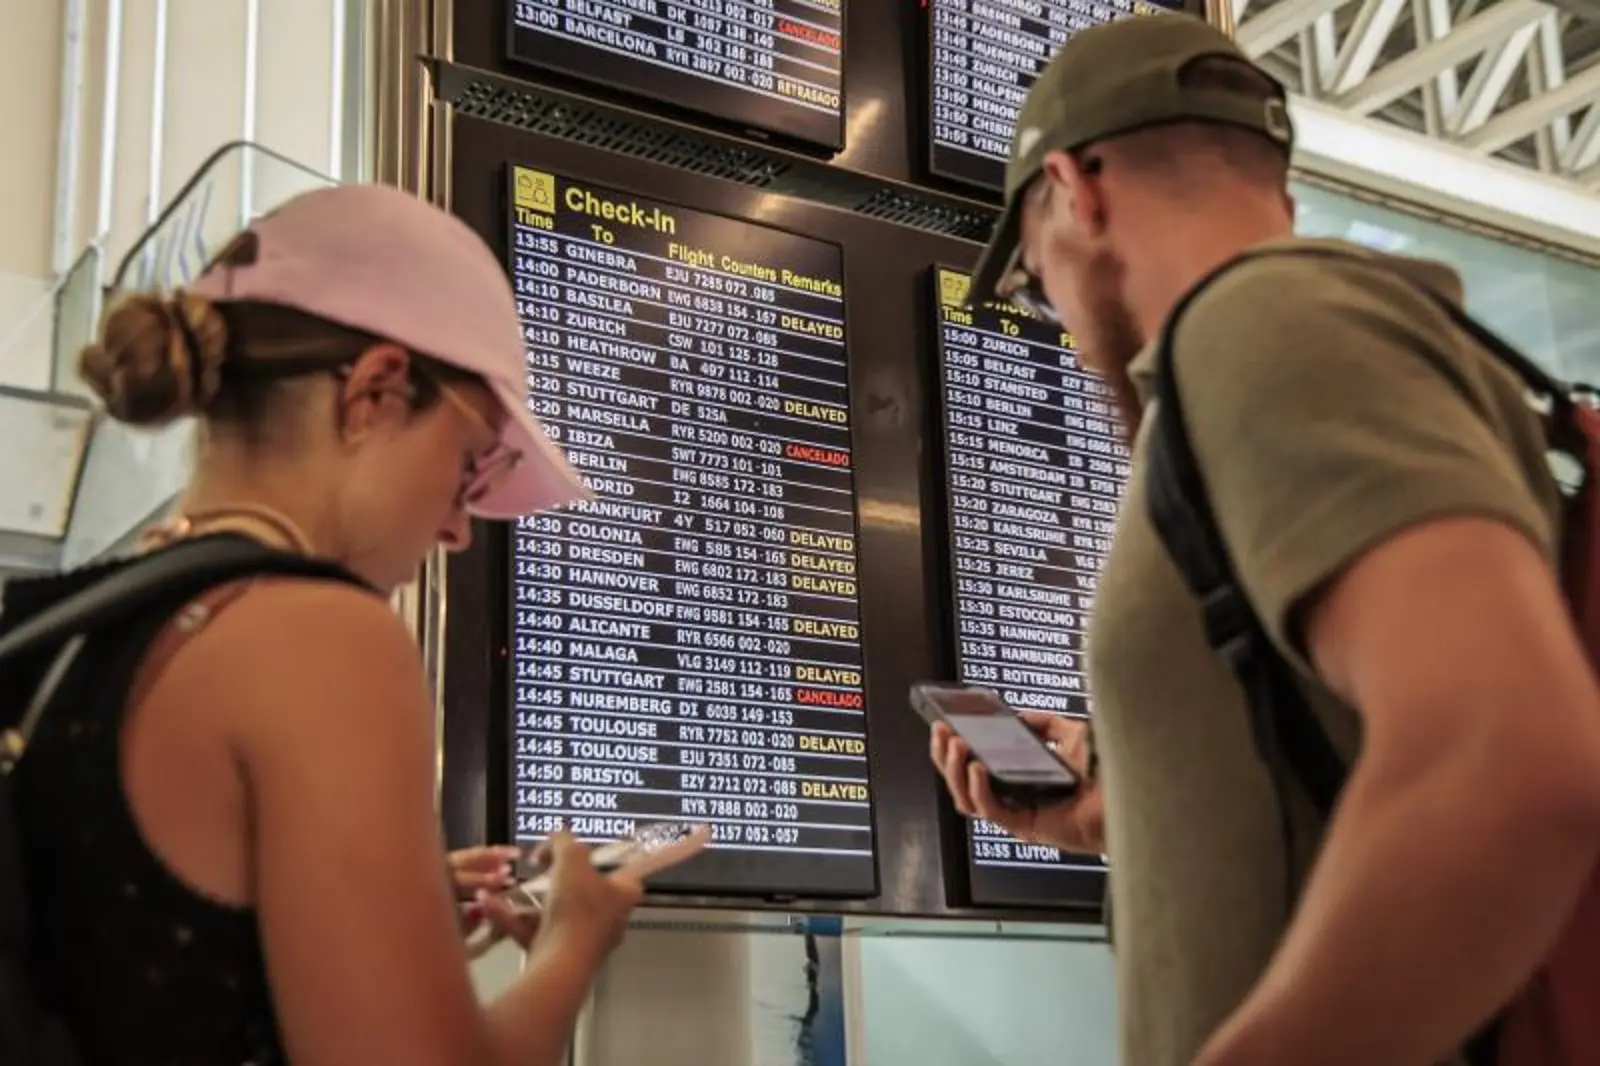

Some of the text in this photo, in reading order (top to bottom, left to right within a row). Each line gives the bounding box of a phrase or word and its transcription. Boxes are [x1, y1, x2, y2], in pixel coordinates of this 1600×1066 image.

[566, 0, 632, 27] BELFAST
[667, 6, 686, 23] DK
[972, 20, 1045, 55] PADERBORN
[516, 4, 839, 109] 13:00 BARCELONA RETRASADO
[972, 60, 1018, 84] ZURICH
[972, 135, 1011, 156] VIENA
[515, 207, 842, 297] Time To Flight Counters Remarks
[516, 231, 689, 284] 13:55 GINEBRA EJU
[516, 255, 842, 339] 14:00 PADERBORN DELAYED
[516, 277, 724, 336] 14:10 BASILEA EJU 7277
[516, 300, 724, 357] 14:10 ZURICH 101
[943, 306, 973, 325] Time
[1000, 319, 1020, 336] To
[567, 334, 656, 364] HEATHROW
[669, 355, 689, 371] BA
[943, 327, 1029, 358] 15:00 ZURICH
[944, 348, 1037, 381] 15:05 BELFAST
[525, 349, 847, 424] 4:15 WEEZE DELAYED
[526, 373, 689, 416] 4:20 STUTTGART DE
[945, 368, 1048, 402] 15:10 STANSTED
[947, 388, 1032, 418] 15:10 BERLIN
[527, 397, 560, 416] 4:20
[567, 404, 649, 432] MARSELLA
[671, 423, 695, 439] RYR
[786, 444, 849, 466] CANCELADO
[948, 409, 1018, 436] 15:15 LINZ
[567, 428, 614, 449] IBIZA
[671, 446, 696, 463] SWT
[699, 451, 728, 468] 7773
[568, 450, 627, 473] BERLIN
[949, 431, 1049, 462] 15:15 MENORCA
[950, 451, 1065, 485] 15:15 AMSTERDAM
[574, 474, 634, 497] ADRID
[952, 473, 1062, 504] 15:20 STUTTGART
[568, 497, 853, 552] FRANKFURT 4Y 517 DELAYED
[953, 494, 1059, 525] 15:20 ZARAGOZA
[516, 513, 854, 574] 14:30 COLONIA DELAYED
[954, 514, 1066, 544] 15:20 KARLSRUHE
[955, 535, 1047, 561] 15:25 SEVILLA
[517, 537, 856, 596] 14:30 DRESDEN EWG 6802 DELAYED
[517, 560, 700, 597] 14:30 HANNOVER EWG
[957, 556, 1034, 580] 15:25 JEREZ
[958, 577, 1070, 606] 15:30 KARLSRUHE
[517, 585, 858, 639] 14:35 DUSSELDORF 9581 DELAYED
[959, 598, 1074, 627] 15:30 ESTOCOLMO
[517, 611, 701, 645] 14:40 ALICANTE RYR
[960, 619, 1070, 646] 15:35 HANNOVER
[517, 636, 562, 655] 14:40
[569, 641, 638, 663] MALAGA
[677, 653, 701, 669] VLG
[704, 656, 736, 673] 3149
[795, 665, 861, 685] DELAYED
[962, 641, 1073, 667] 15:35 HAMBURGO
[517, 661, 862, 708] 14:45 STUTTGART 2581 CANCELADO
[963, 663, 1080, 689] 15:35 ROTTERDAM
[517, 686, 562, 705] 14:45
[570, 691, 671, 714] NUREMBERG
[679, 701, 698, 717] DI
[1003, 689, 1068, 710] GLASGOW
[517, 711, 865, 754] 14:45 TOULOUSE RYR 7752 DELAYED
[517, 737, 738, 768] 14:45 TOULOUSE EJU 7351
[517, 762, 562, 780] 14:50
[570, 765, 644, 785] BRISTOL
[681, 773, 705, 789] EZY
[709, 775, 740, 792] 2712
[801, 782, 867, 800] DELAYED
[517, 788, 740, 816] 14:55 CORK 7888
[518, 814, 635, 836] 14:55 ZURICH
[1014, 845, 1060, 861] LUTON
